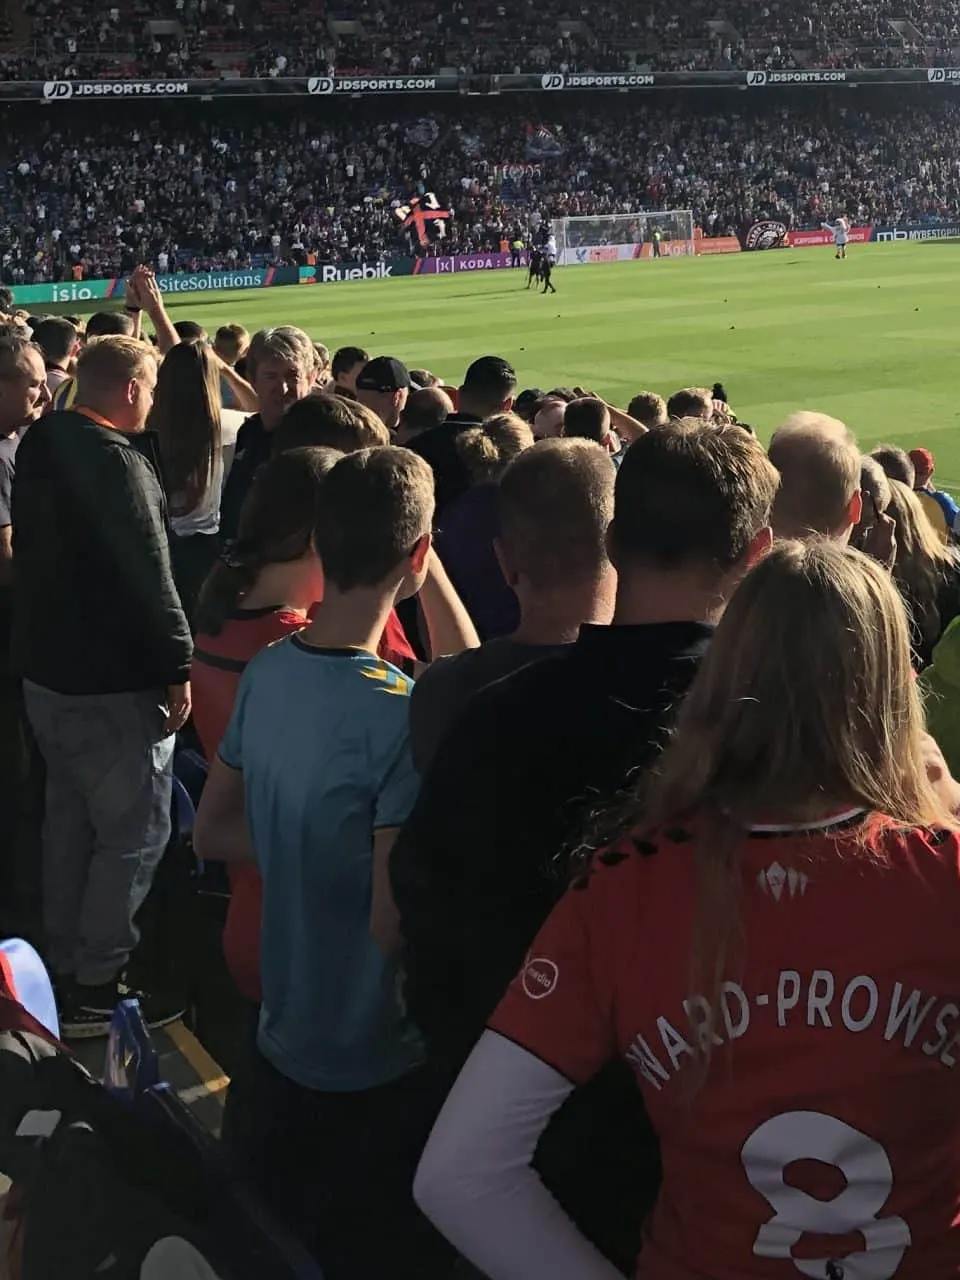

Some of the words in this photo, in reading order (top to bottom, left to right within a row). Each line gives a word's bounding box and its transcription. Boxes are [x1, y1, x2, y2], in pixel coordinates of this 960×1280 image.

[566, 75, 654, 86] JDSPORTS.COM
[768, 72, 846, 82] JDSPORTS.COM
[75, 83, 189, 95] JDSPORTS.COM
[335, 79, 436, 90] JDSPORTS.COM
[460, 259, 493, 270] KODA
[322, 262, 393, 283] Ruebik
[53, 285, 97, 302] isio.
[740, 1110, 912, 1280] 8
